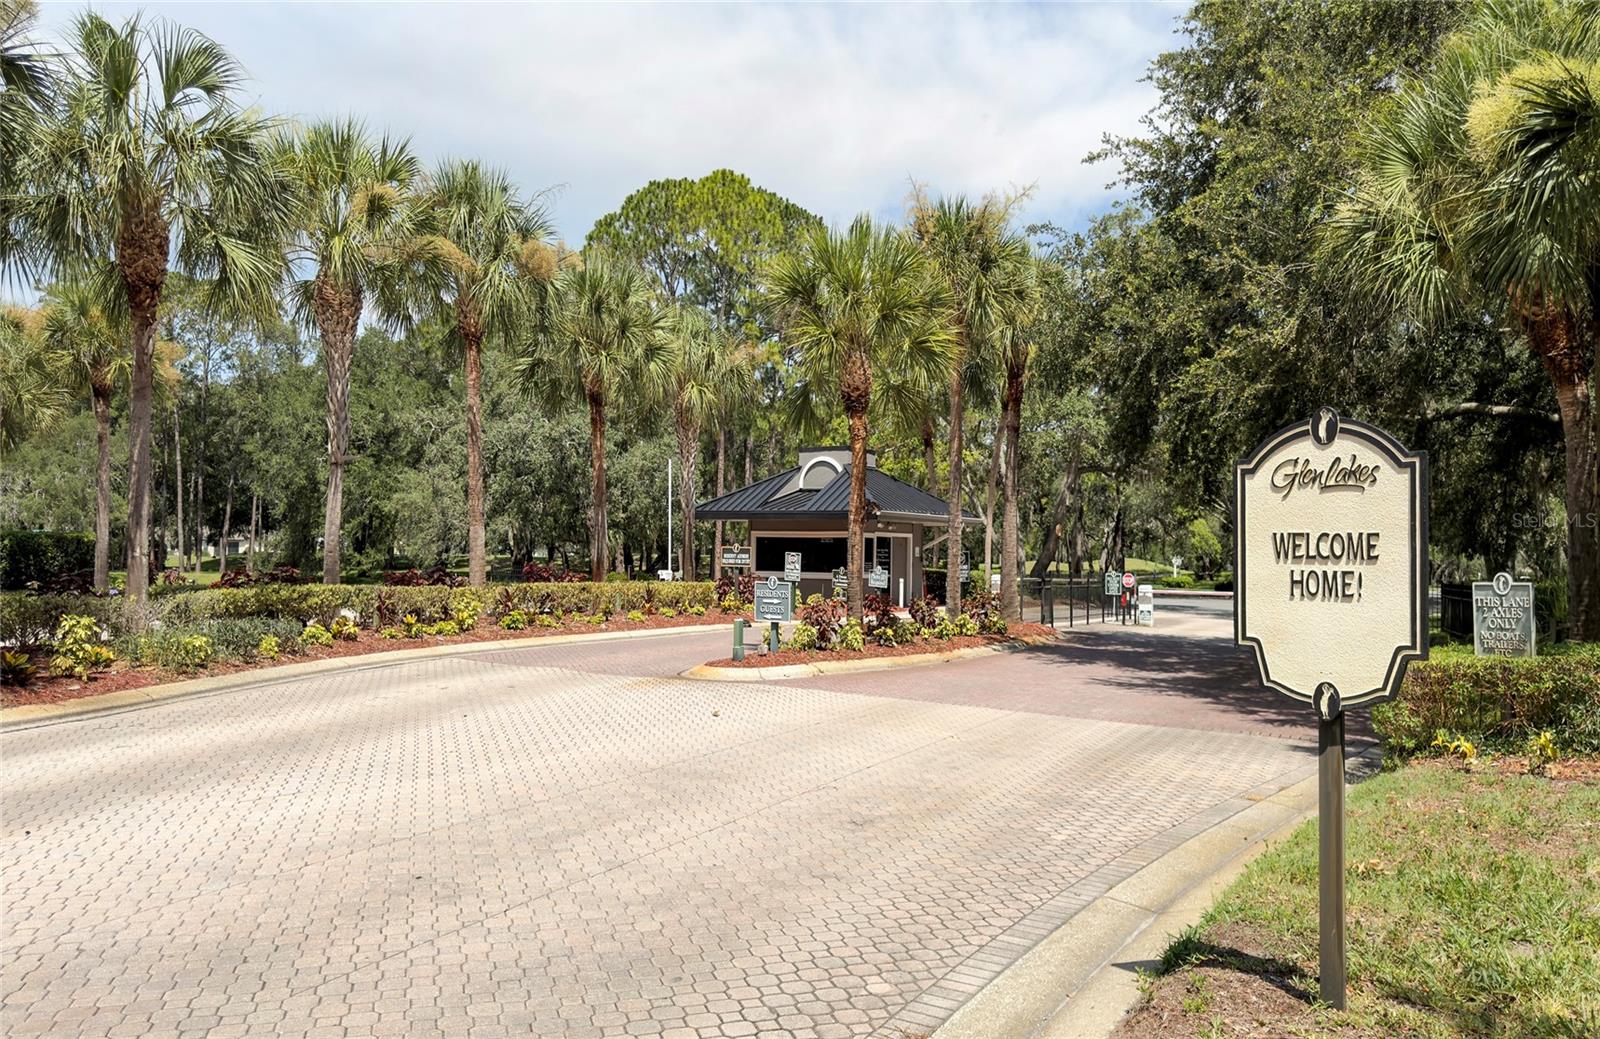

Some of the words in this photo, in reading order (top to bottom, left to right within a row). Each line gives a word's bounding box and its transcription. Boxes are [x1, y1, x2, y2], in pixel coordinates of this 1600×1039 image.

[1272, 532, 1380, 561] WELCOME
[1290, 569, 1363, 599] HOME!
[756, 589, 789, 598] RESIDENTS
[1475, 597, 1500, 607] THIS
[1502, 597, 1530, 607] LANE
[760, 605, 785, 614] GUESTS
[1482, 607, 1488, 617] 2
[1491, 607, 1523, 618] AXLES
[1488, 618, 1517, 629] ONLY
[1481, 631, 1495, 639] NO
